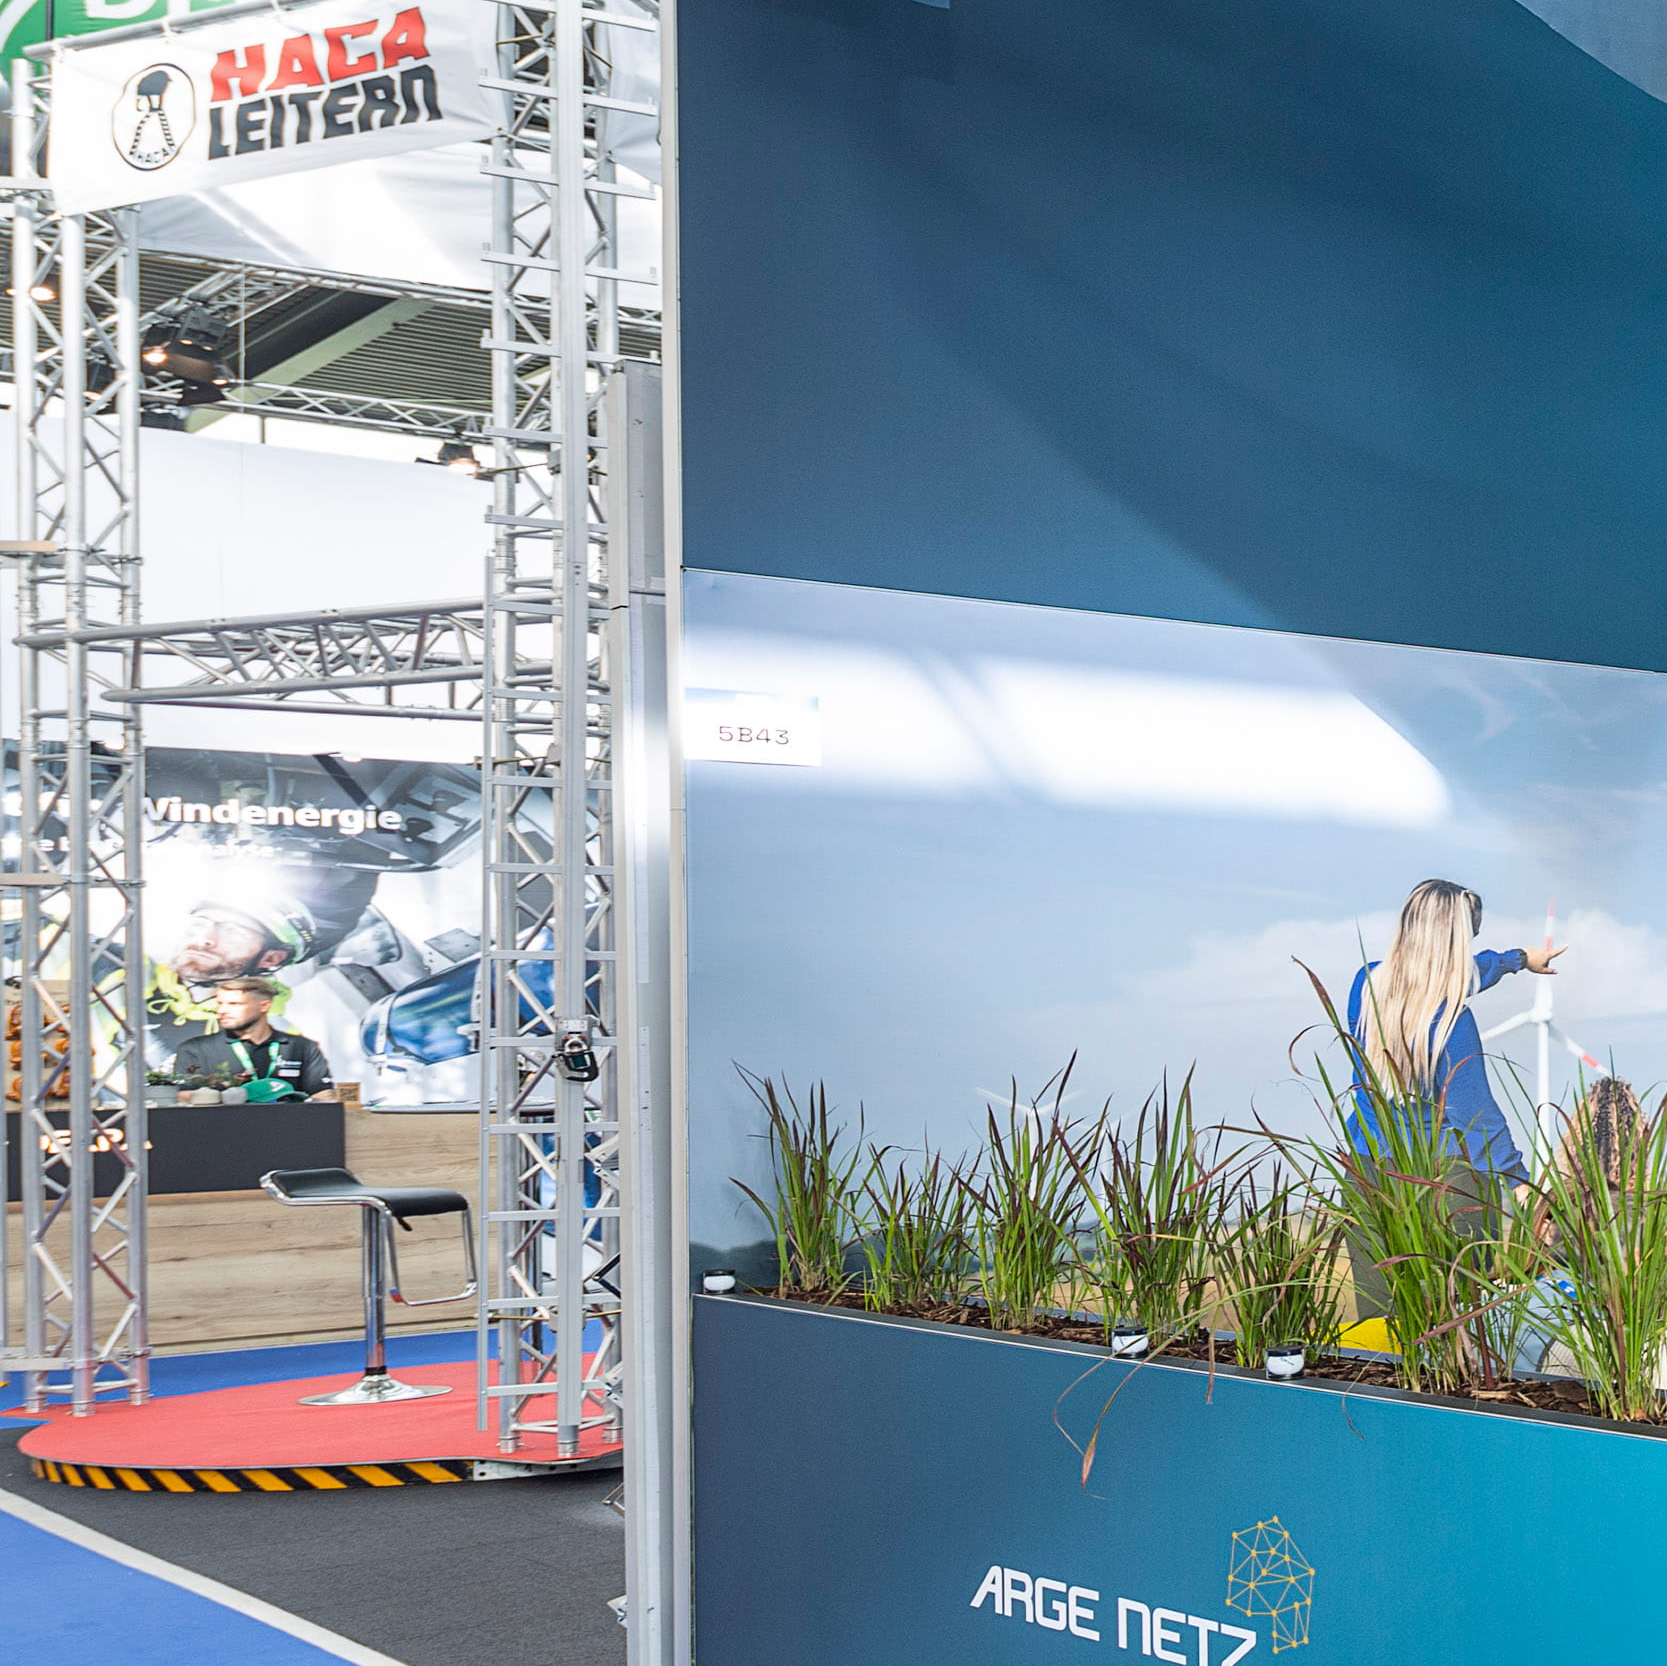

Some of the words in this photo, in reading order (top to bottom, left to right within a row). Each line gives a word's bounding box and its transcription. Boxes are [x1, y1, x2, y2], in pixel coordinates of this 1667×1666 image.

[210, 6, 431, 103] HACA
[208, 64, 443, 160] LEITERN
[718, 725, 790, 746] 5B43
[969, 1564, 1100, 1642] ARGE
